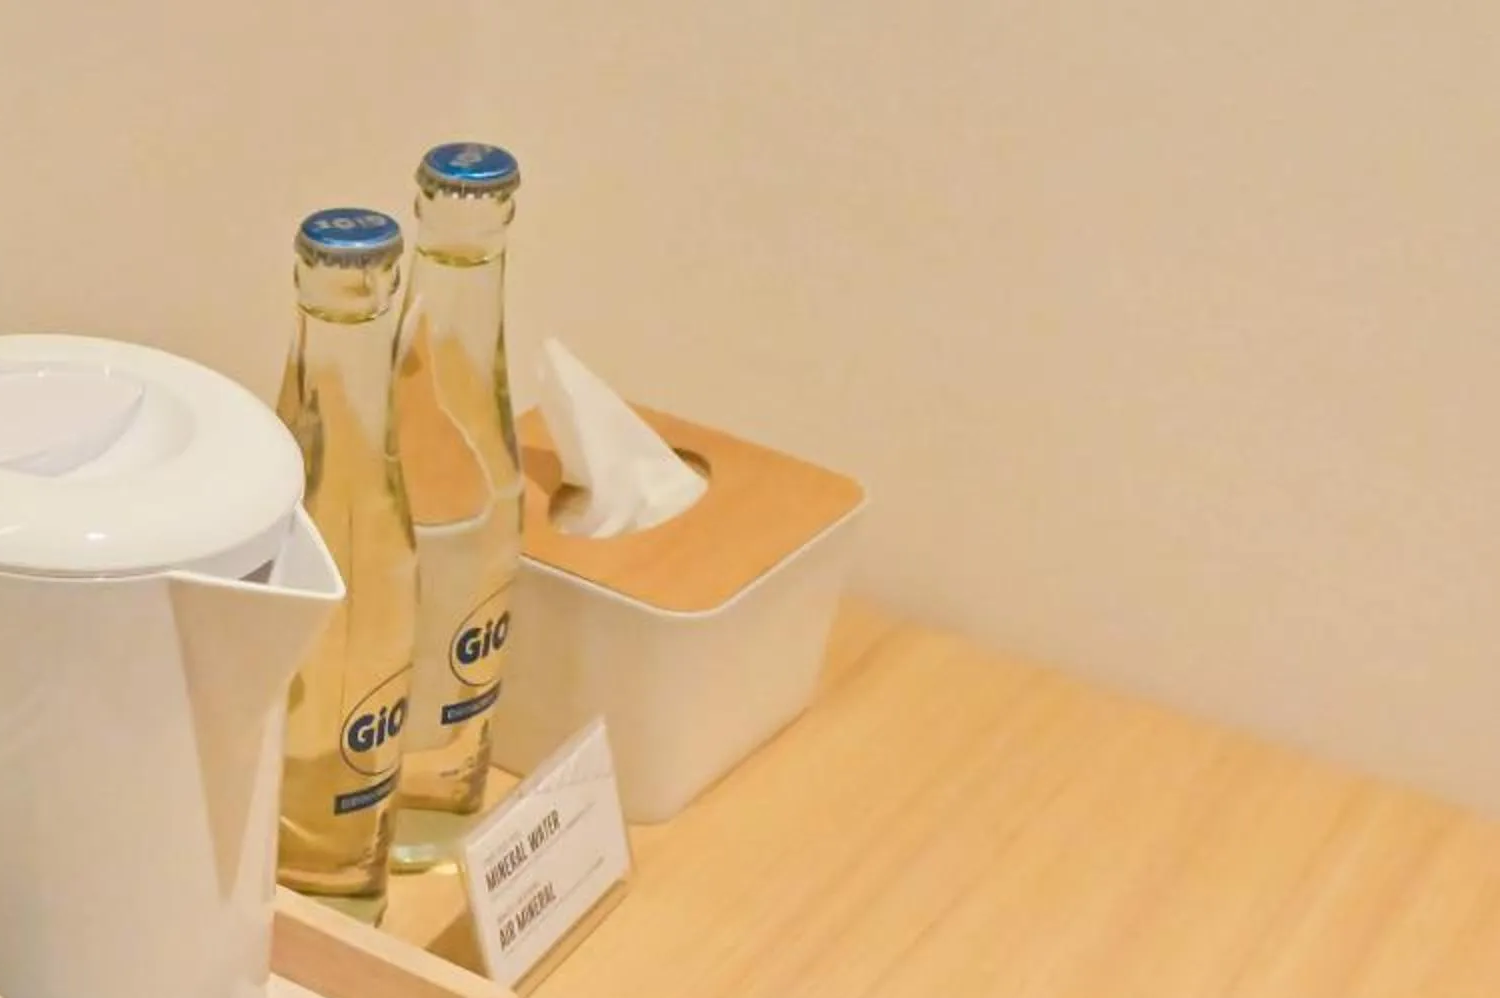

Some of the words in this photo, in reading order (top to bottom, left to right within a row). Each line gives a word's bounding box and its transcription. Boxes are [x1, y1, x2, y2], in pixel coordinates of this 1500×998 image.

[484, 839, 529, 892] MINERAL
[527, 809, 561, 853] WATER
[514, 880, 558, 932] MINERAL
